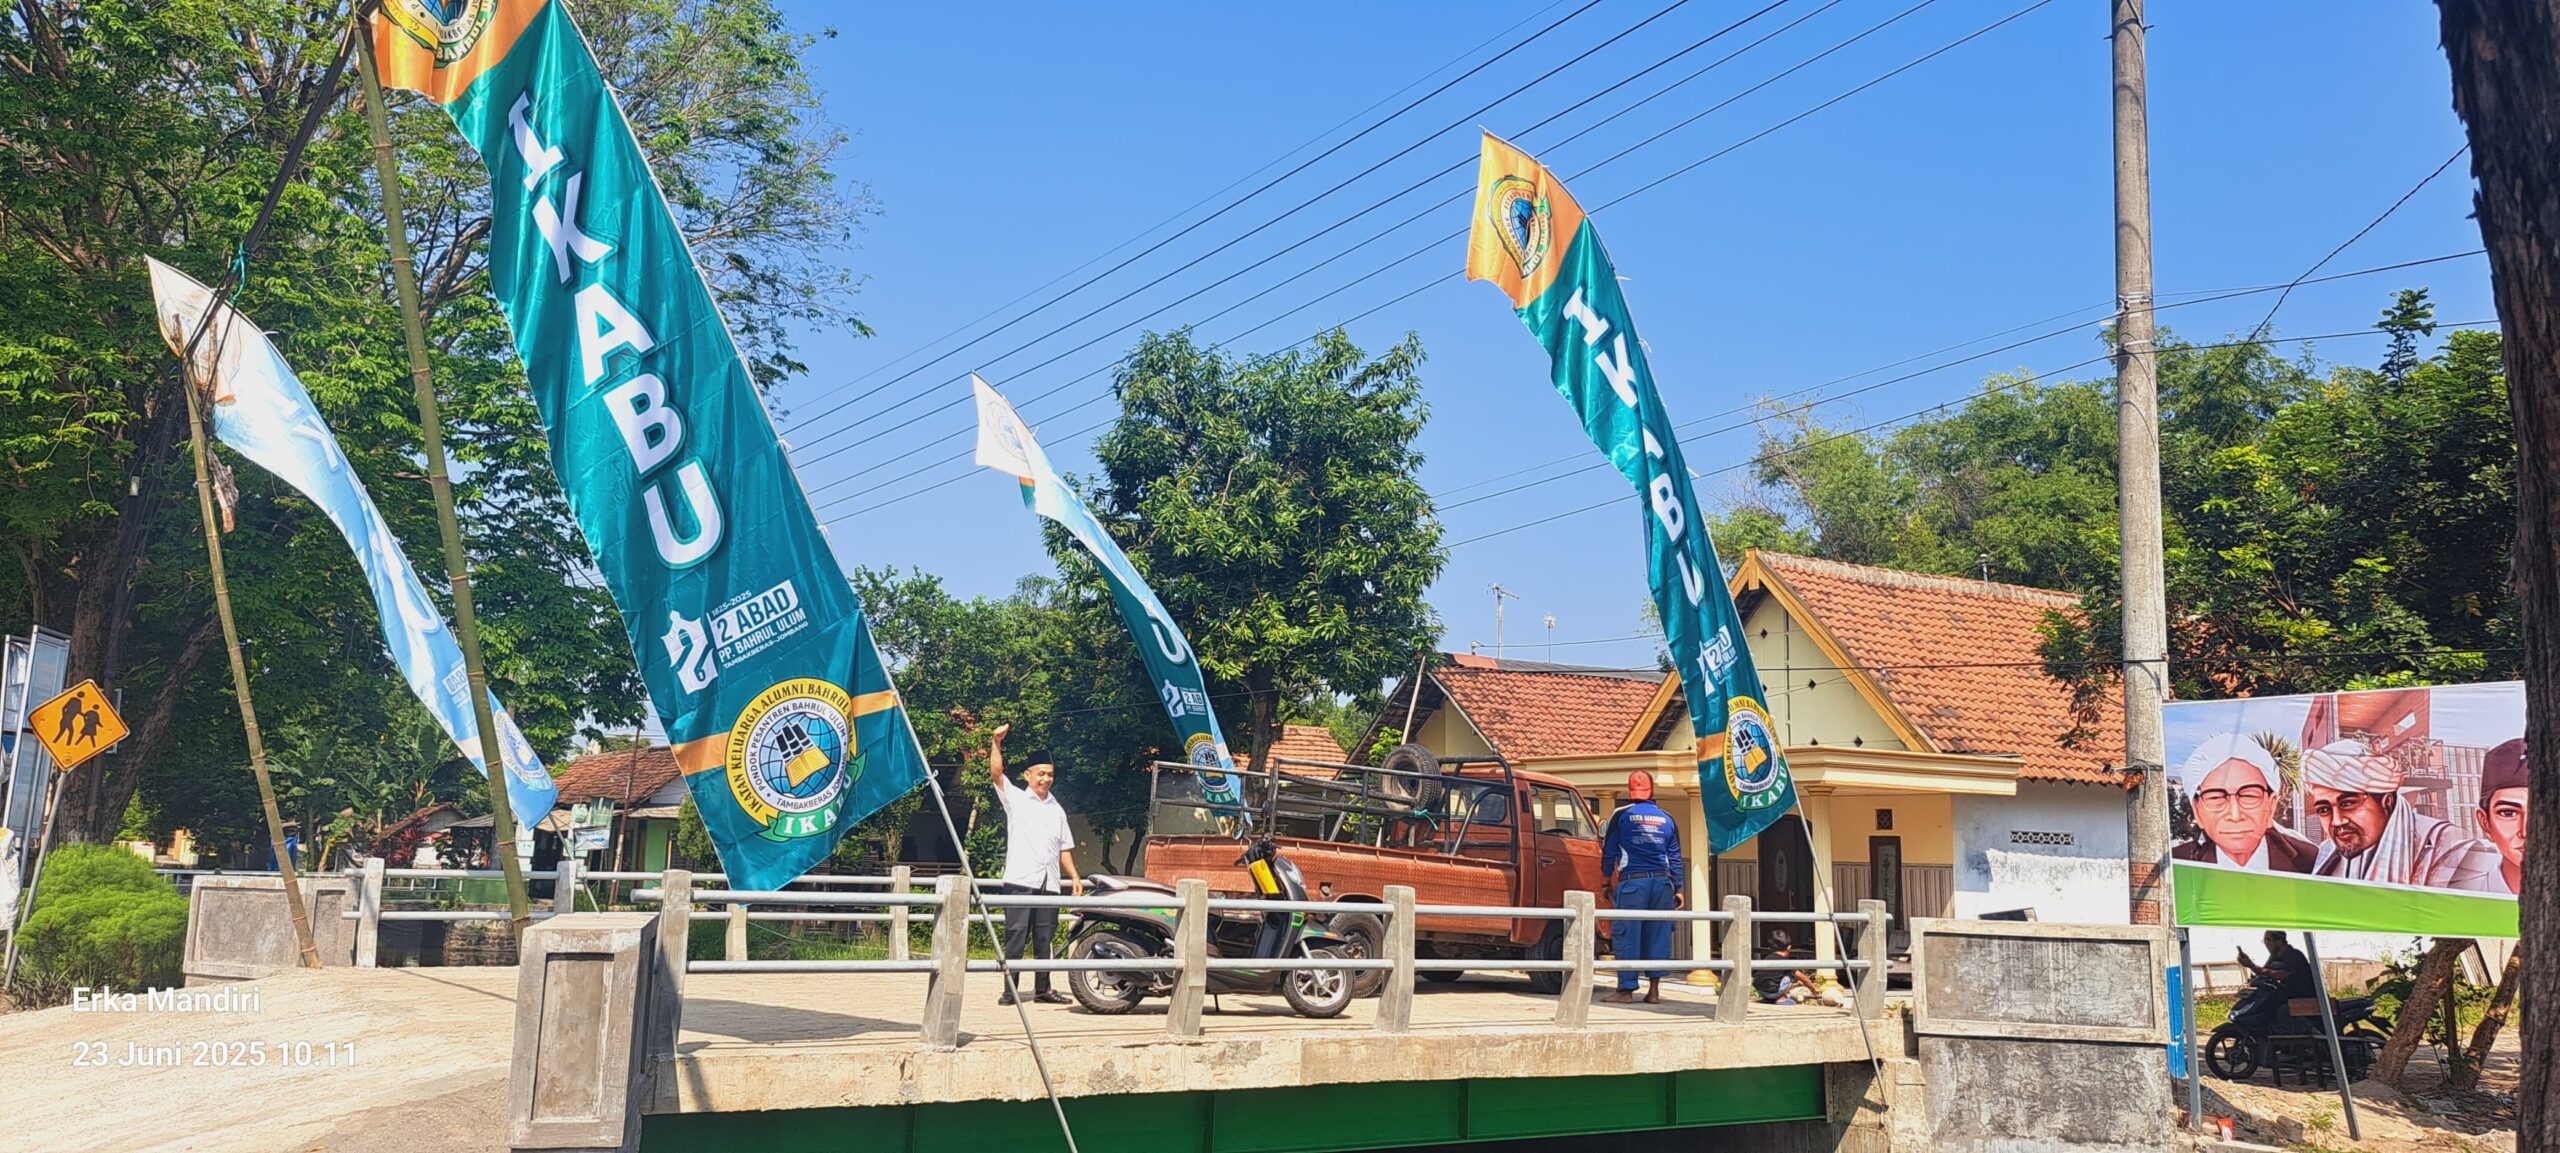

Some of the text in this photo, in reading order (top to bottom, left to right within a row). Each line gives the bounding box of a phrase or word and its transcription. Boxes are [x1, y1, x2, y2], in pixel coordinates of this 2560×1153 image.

[508, 91, 722, 567] IKABU
[711, 590, 752, 617] 1825-2025
[717, 587, 790, 643] 2 ABAD
[718, 608, 806, 663] PP. BAHRUL ULUM
[760, 683, 804, 709] ALUMNI
[792, 702, 827, 713] BAHRUL
[807, 683, 849, 713] BAHRUL
[731, 707, 762, 770] KELUARGA
[751, 707, 790, 749] PESANTREN
[749, 751, 765, 791] PONDOK
[1743, 765, 1787, 808] IKABU
[733, 775, 764, 814] IKATAN
[776, 791, 833, 809] TAMBAKBERAS
[783, 774, 852, 834] IKABU
